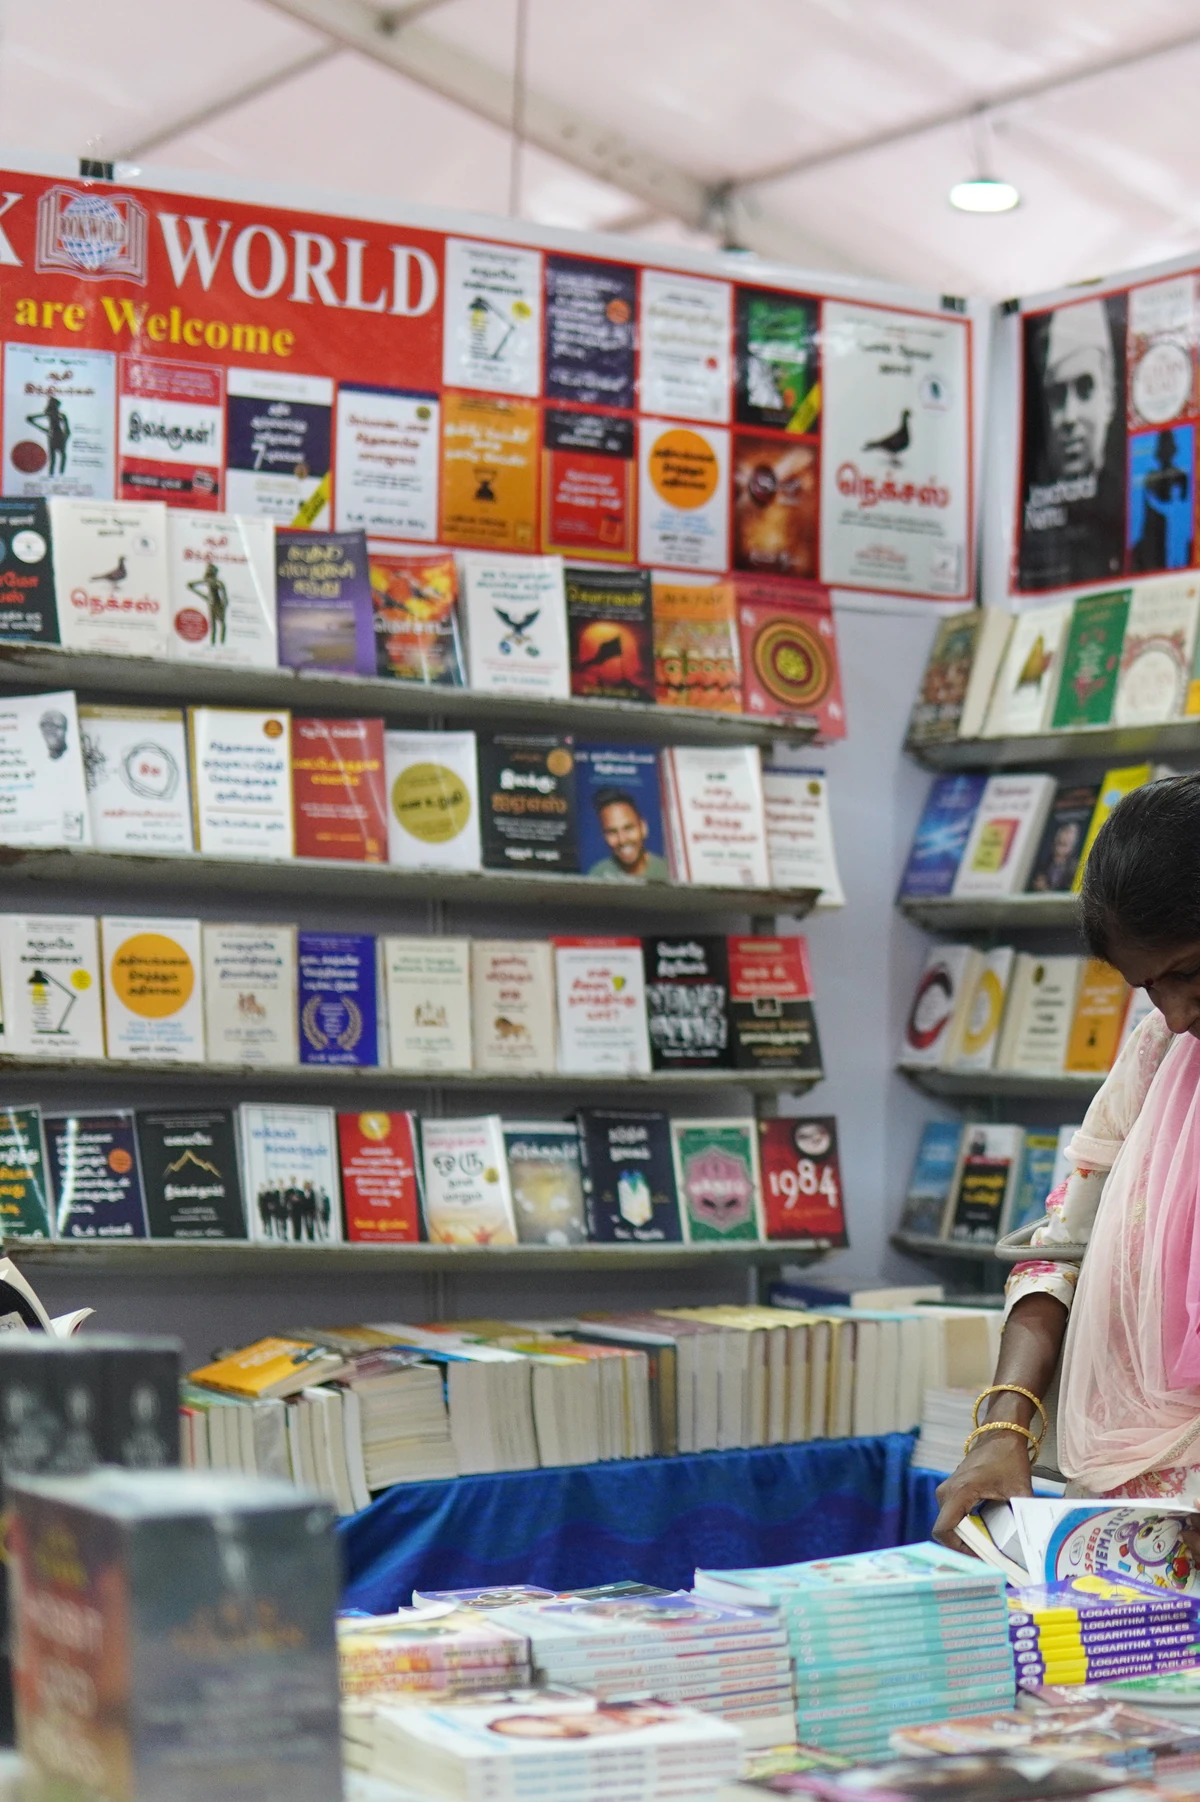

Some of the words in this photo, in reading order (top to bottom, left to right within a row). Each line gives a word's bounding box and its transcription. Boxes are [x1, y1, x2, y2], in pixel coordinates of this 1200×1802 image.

[157, 211, 438, 318] WORLD
[15, 297, 86, 332] are
[101, 295, 294, 358] Welcome
[768, 1157, 839, 1210] 1984
[1083, 1526, 1101, 1575] SPEED
[1094, 1507, 1137, 1572] HEMATICS
[1080, 1603, 1147, 1619] LOGARITHM
[1150, 1599, 1193, 1613] TABLES
[1084, 1614, 1147, 1632] LOGARITHM
[1150, 1610, 1189, 1624] TABLES
[1083, 1627, 1147, 1644] LOGARITHM
[1150, 1622, 1191, 1636] TABLES
[1087, 1639, 1151, 1656] LOGARITHM
[1154, 1633, 1196, 1647] TABLES
[1088, 1663, 1153, 1680] LOGARITHM
[1154, 1657, 1197, 1671] TABLES
[1091, 1652, 1153, 1668] LOGARITHM
[1156, 1647, 1198, 1661] TABLES
